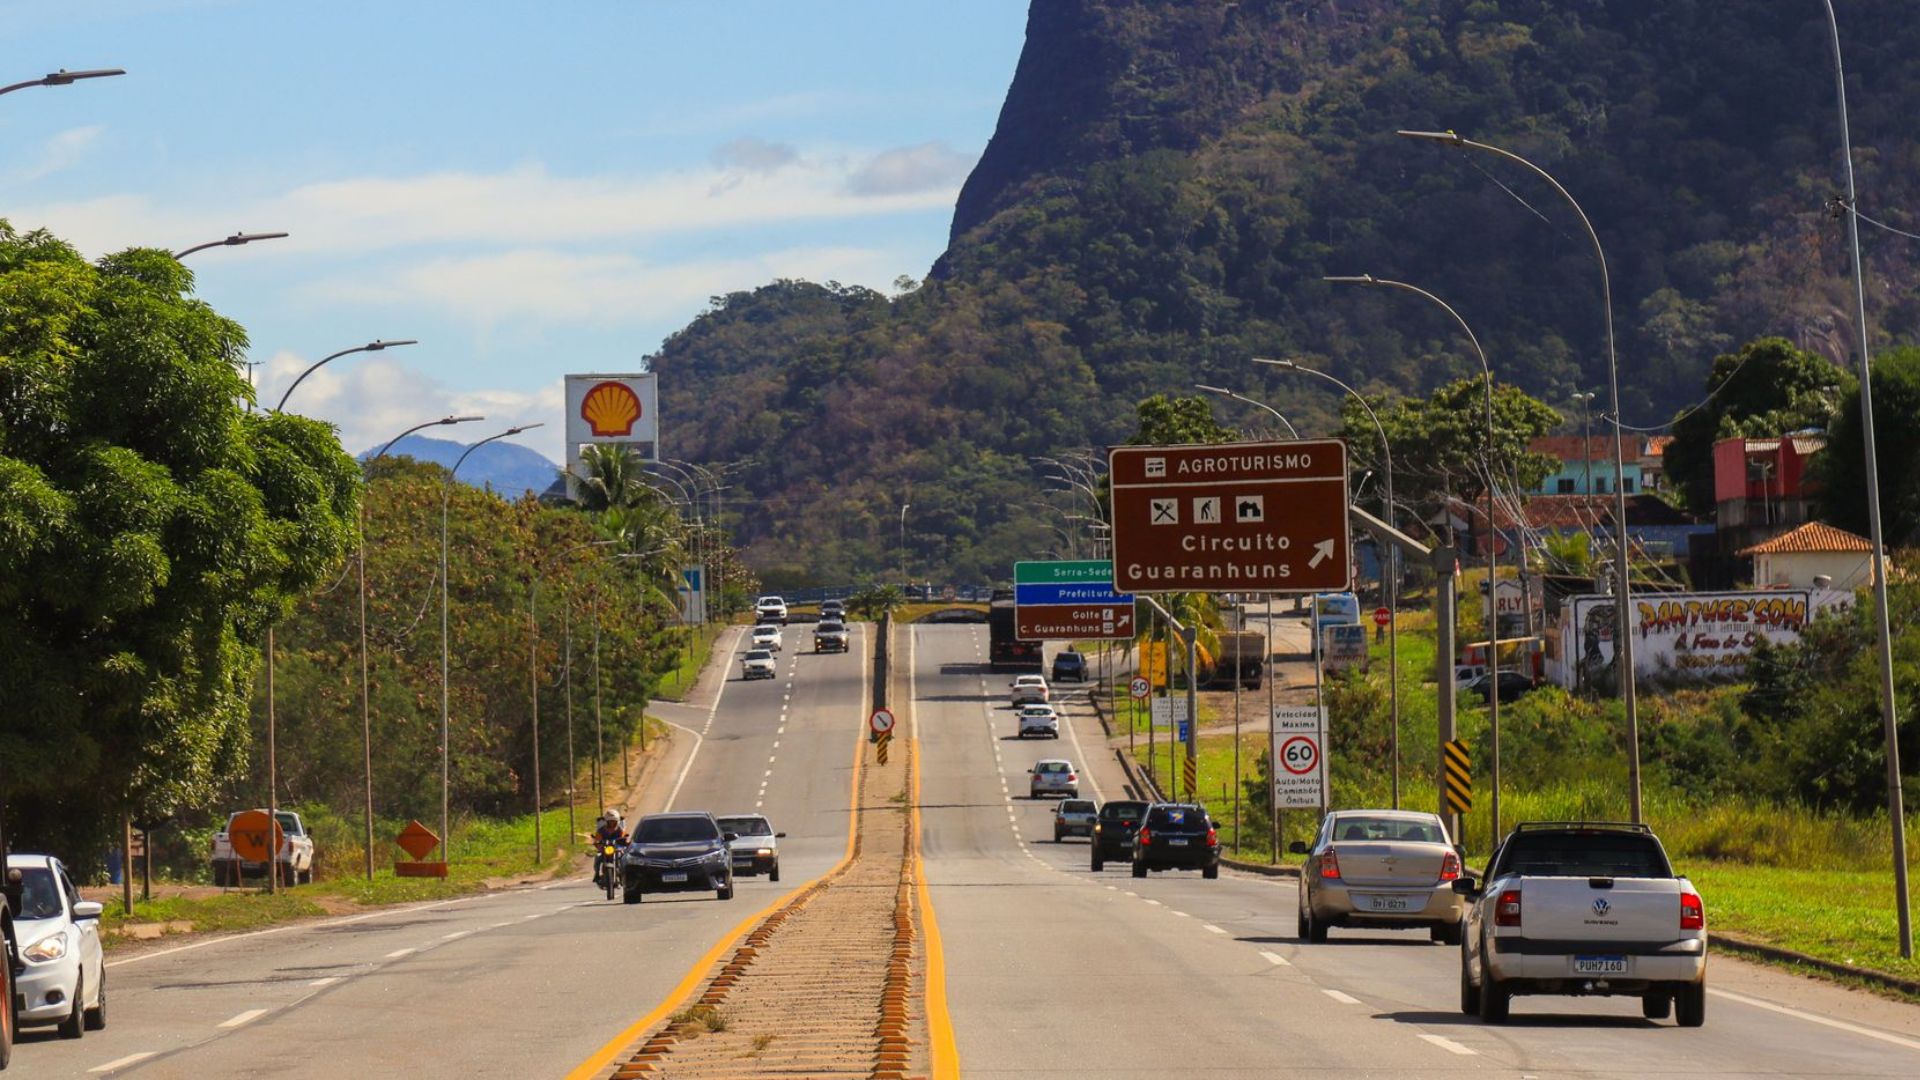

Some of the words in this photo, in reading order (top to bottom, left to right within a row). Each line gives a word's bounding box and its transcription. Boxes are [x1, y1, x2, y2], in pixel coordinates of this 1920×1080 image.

[1178, 454, 1311, 473] AGROTURISMO
[1182, 533, 1290, 551] Circuito
[1128, 562, 1291, 579] Guaranhuns
[1059, 590, 1113, 598] Prefeitura
[1073, 611, 1100, 619] Golfe
[1020, 625, 1030, 634] C.
[1034, 624, 1100, 633] Guaranhuns
[1132, 682, 1147, 691] 60
[1275, 711, 1318, 719] Velocidad
[1287, 745, 1312, 761] 60
